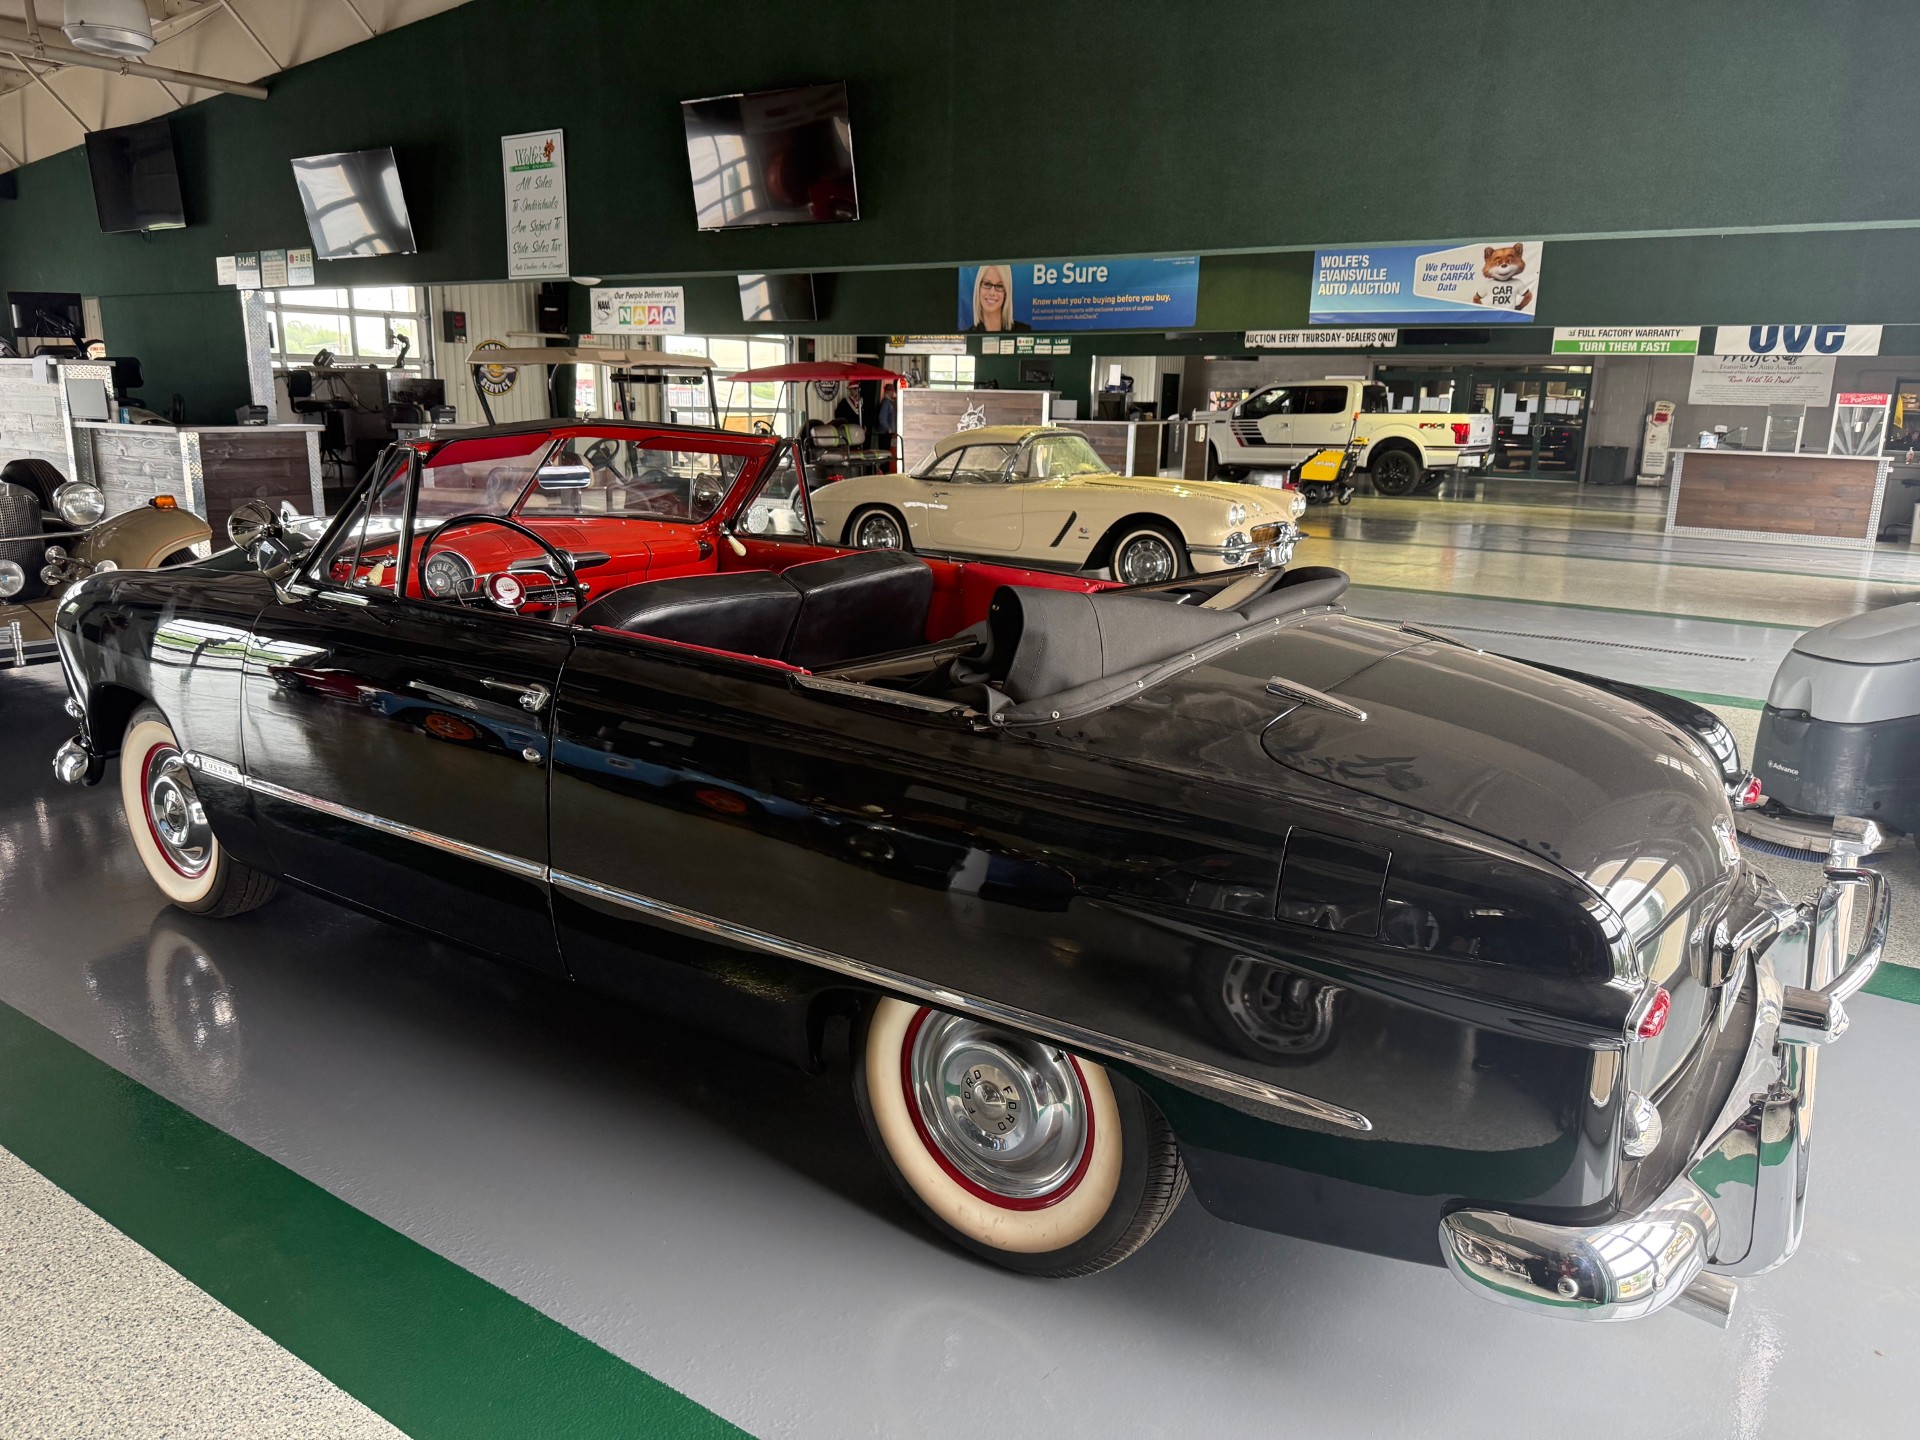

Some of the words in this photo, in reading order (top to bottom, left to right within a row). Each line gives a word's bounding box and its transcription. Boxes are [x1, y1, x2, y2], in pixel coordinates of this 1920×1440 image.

[515, 146, 543, 165] Wolfe's
[516, 176, 532, 192] All
[534, 174, 553, 189] Sales
[512, 199, 520, 212] To
[520, 196, 559, 213] Individuals
[512, 220, 527, 233] Are
[529, 218, 552, 237] Subject
[554, 216, 562, 230] To
[512, 241, 528, 254] State
[531, 240, 550, 253] Sales
[551, 238, 563, 252] Tax
[1320, 254, 1370, 269] WOLFE'S
[1425, 262, 1439, 272] We
[1440, 261, 1475, 273] Proudly
[1033, 263, 1058, 285] Be
[1062, 262, 1109, 284] Sure
[1319, 268, 1388, 282] EVANSVILLE
[1422, 273, 1439, 282] Use
[1440, 271, 1475, 281] CARFAX
[1317, 282, 1348, 296] AUTO
[1350, 281, 1401, 295] AUCTION
[1436, 282, 1458, 292] Data
[1492, 286, 1513, 296] CAR
[614, 291, 625, 300] Our
[625, 291, 643, 300] People
[644, 290, 663, 299] Deliver
[664, 290, 680, 299] Value
[1032, 297, 1051, 305] Know
[1052, 296, 1069, 305] what
[1070, 296, 1092, 306] you're
[1092, 296, 1116, 305] buying
[1117, 294, 1141, 303] before
[1141, 295, 1155, 304] you
[1156, 293, 1171, 303] buy.
[1492, 295, 1512, 305] FOX
[1245, 333, 1276, 344] AUCTION
[1279, 333, 1300, 343] EVERY
[1377, 332, 1396, 342] ONLY
[1577, 329, 1596, 338] FULL
[1598, 329, 1633, 337] FACTORY
[1579, 342, 1606, 352] TURN
[1608, 342, 1637, 352] THEM
[1640, 341, 1671, 352] FAST!
[480, 378, 512, 394] SERVICE
[1745, 375, 1763, 383] With
[1763, 375, 1774, 383] The
[1850, 394, 1883, 404] POPCORN
[1419, 422, 1446, 430] FX4
[203, 761, 233, 776] CUSTOM
[1773, 762, 1799, 776] Advance
[963, 1069, 982, 1115] FORD
[998, 1085, 1017, 1131] FORD
